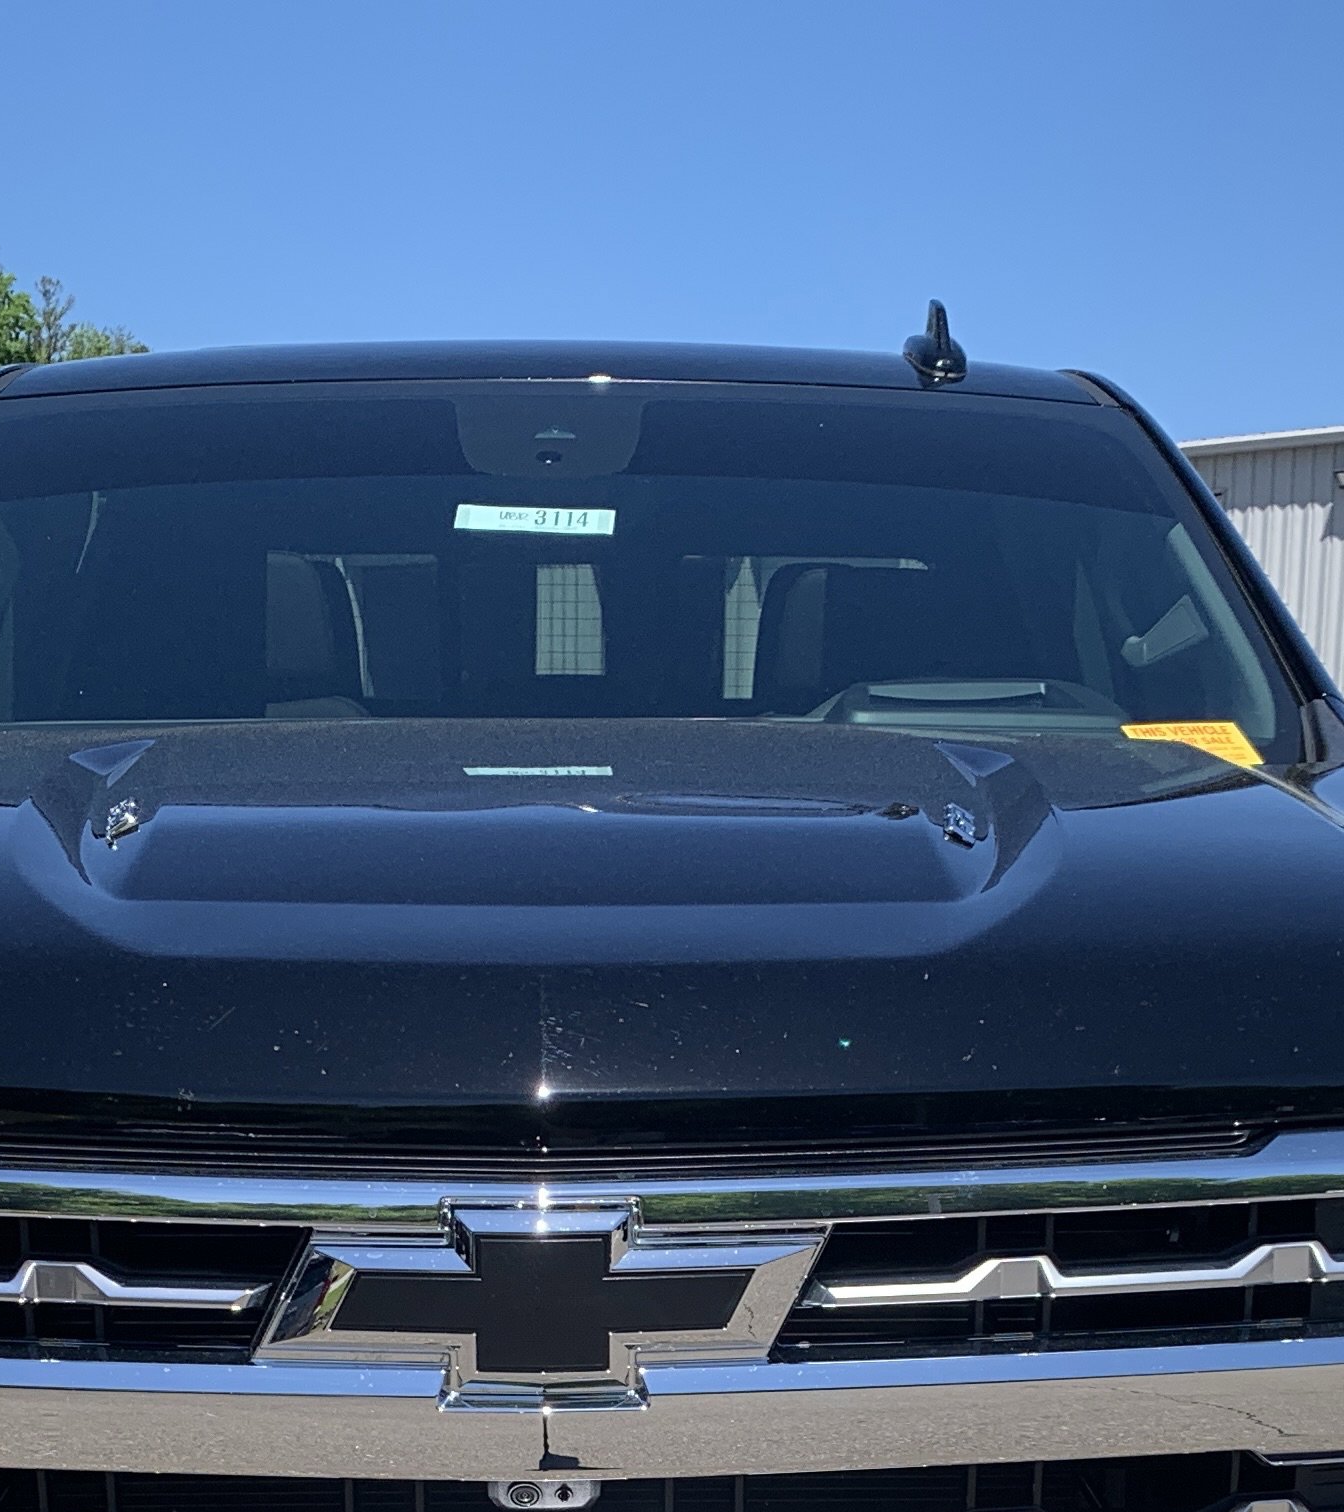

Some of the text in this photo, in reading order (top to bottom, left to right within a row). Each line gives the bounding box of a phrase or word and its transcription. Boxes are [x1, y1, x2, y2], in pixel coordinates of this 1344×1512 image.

[534, 509, 589, 528] 3114
[1129, 725, 1233, 738] THIS VEHICLE
[1203, 736, 1235, 745] SALE
